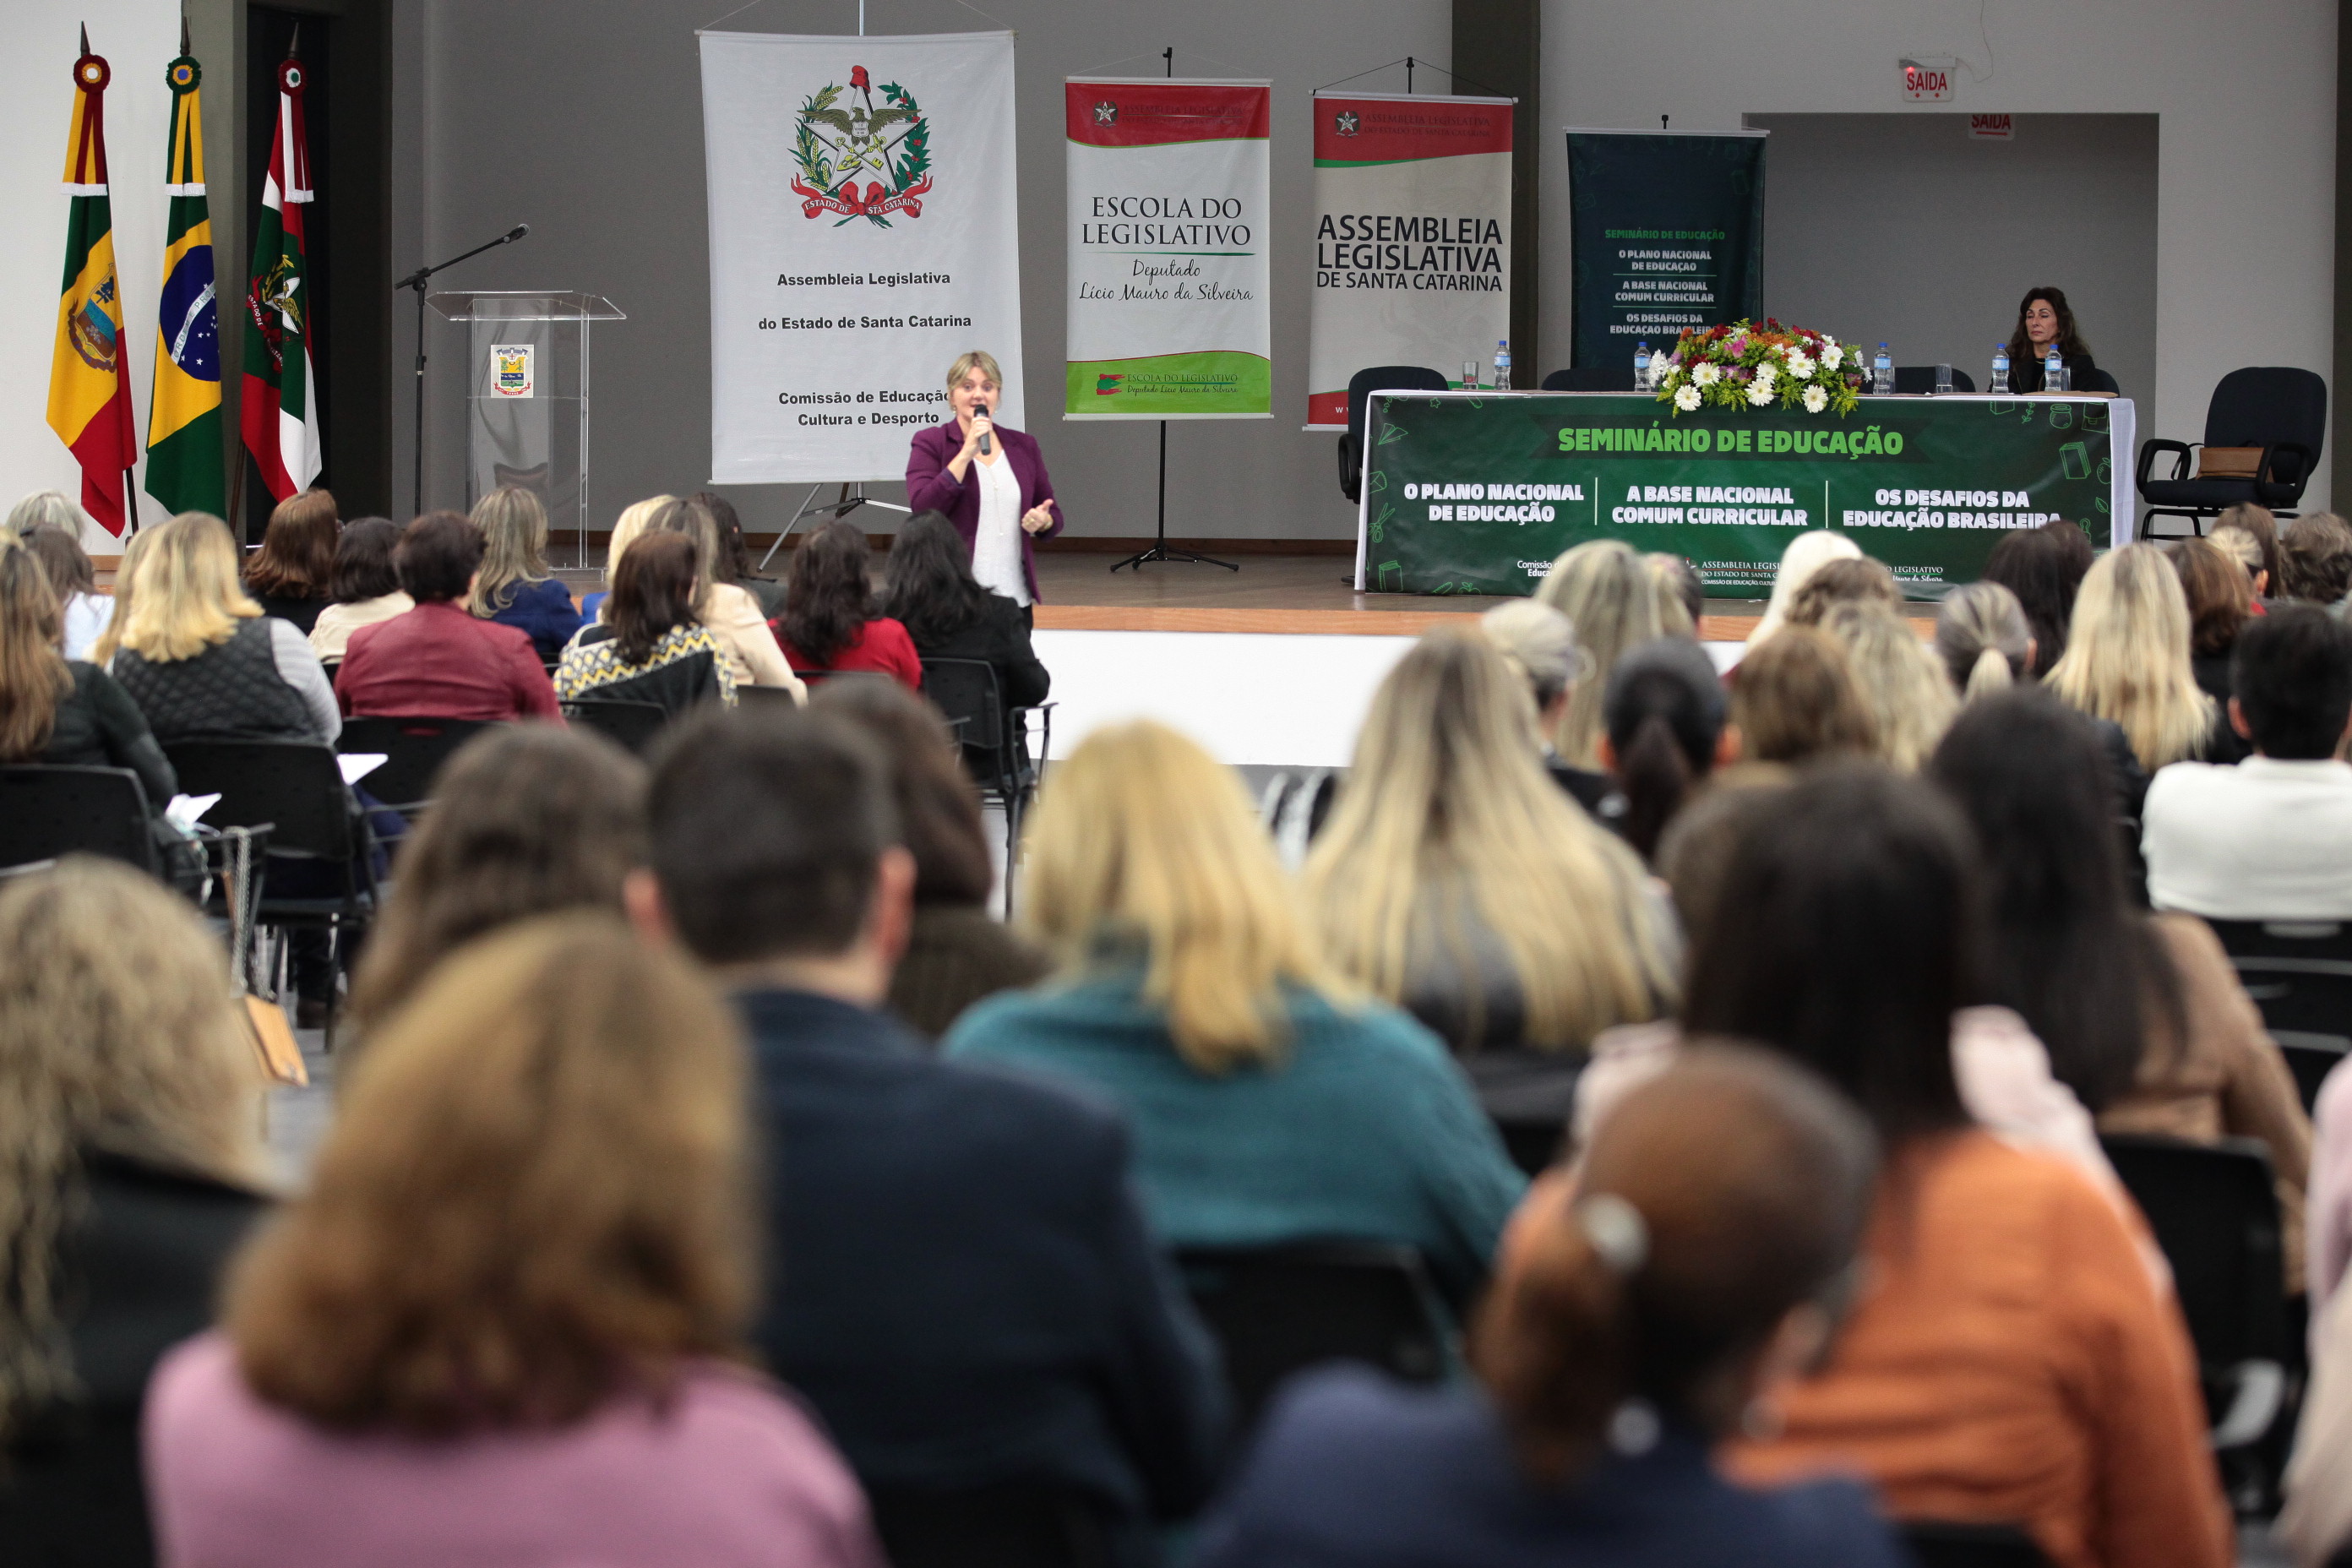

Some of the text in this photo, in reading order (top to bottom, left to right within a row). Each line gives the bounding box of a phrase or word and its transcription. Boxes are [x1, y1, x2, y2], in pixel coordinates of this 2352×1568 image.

[805, 199, 836, 210] ESTADO
[838, 204, 850, 214] DE
[1092, 197, 1242, 218] ESCOLA DO
[1082, 223, 1250, 245] LEGISLATIVO
[1318, 215, 1502, 245] ASSEMBLEIA
[1605, 227, 1659, 239] SEMINÁRIO
[1661, 230, 1673, 239] DE
[1318, 243, 1502, 273] LEGISLATIVA
[1619, 250, 1712, 260] O PLANO NACIONAL
[1133, 259, 1200, 286] Deputado
[1632, 262, 1644, 270] DE
[777, 272, 950, 287] Assembleia Legislativa
[1317, 272, 1502, 291] DE SANTA CATARINA
[1622, 280, 1707, 291] A BASE NACIONAL
[1080, 282, 1254, 301] Lício Mauro da Silveira
[1615, 292, 1715, 302] COMUM CURRICULAR
[759, 314, 972, 330] do Estado de Santa Catarina
[1626, 313, 1703, 323] OS DESAFIOS DA
[779, 391, 852, 405] Comissão
[856, 391, 874, 404] de
[798, 412, 939, 427] Cultura e Desporto
[1558, 420, 1903, 460] SEMINÁRIO DE EDUCAÇÃO
[1404, 483, 1583, 501] O PLANO NACIONAL
[1626, 486, 1794, 504] A BASE NACIONAL
[1876, 488, 2029, 508] OS DESAFIOS DA
[1429, 502, 1554, 525] DE EDUCAÇÃO
[1612, 507, 1808, 525] COMUM CURRICULAR
[1843, 507, 1943, 531] EDUCAÇÃO
[1701, 561, 1782, 570] ASSEMBLEIA LEGISL
